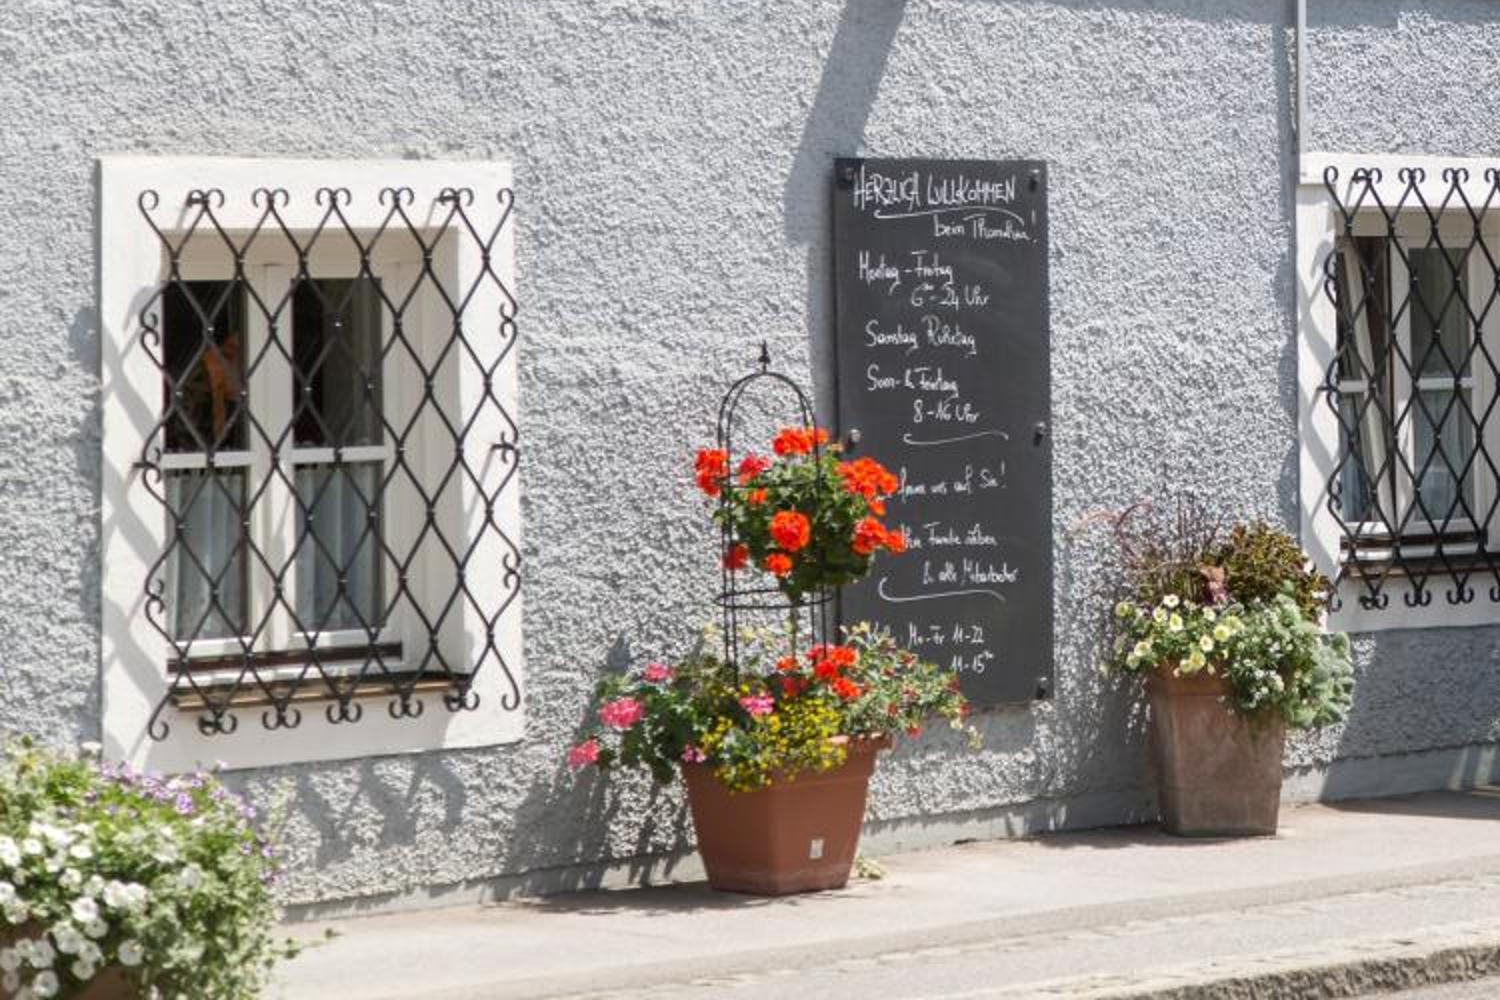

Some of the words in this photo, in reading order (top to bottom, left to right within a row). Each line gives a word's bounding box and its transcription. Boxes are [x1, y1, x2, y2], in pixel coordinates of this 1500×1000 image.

[933, 214, 965, 238] beim
[860, 250, 901, 295] Montag
[964, 284, 990, 306] Uhr
[865, 319, 919, 356] Samstag
[922, 314, 977, 358] Ruhetag
[956, 402, 980, 423] Uhr
